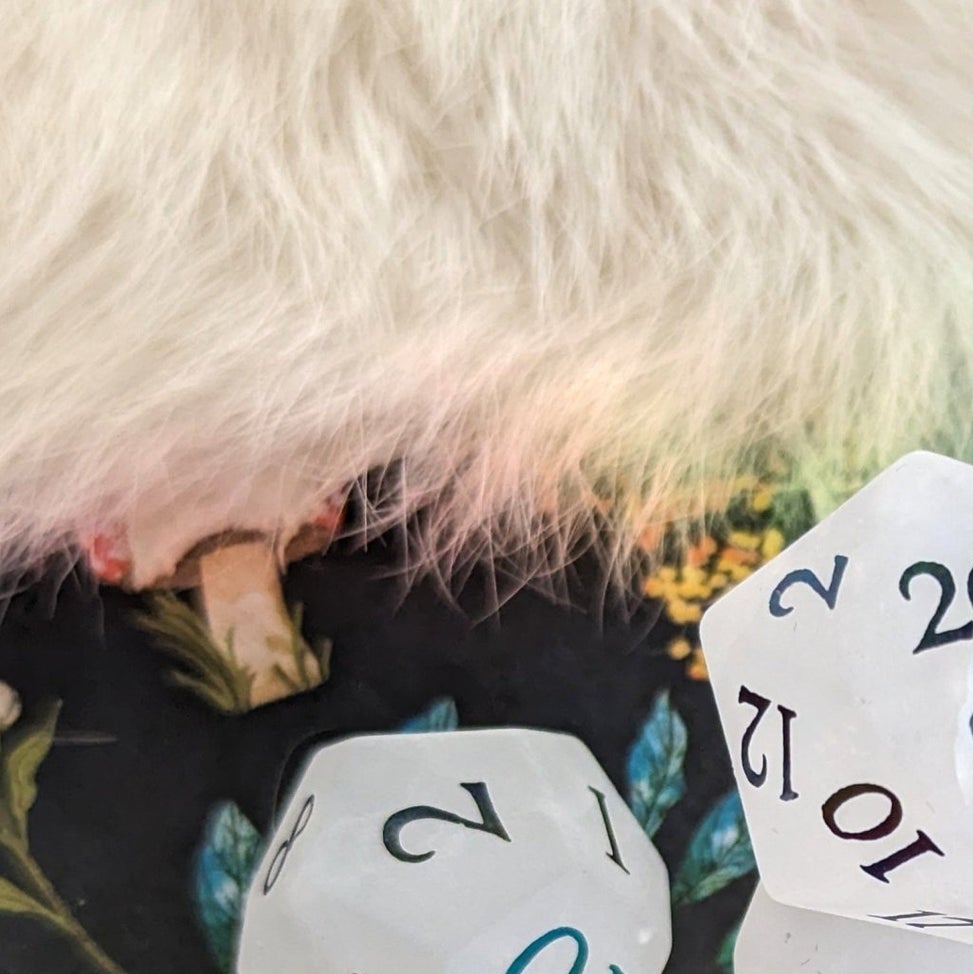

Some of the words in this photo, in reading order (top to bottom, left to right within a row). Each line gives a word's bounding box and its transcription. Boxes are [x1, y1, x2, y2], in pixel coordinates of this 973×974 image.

[768, 553, 848, 617] 2
[738, 685, 799, 801] 12
[263, 794, 315, 895] 8
[381, 781, 511, 863] 2
[821, 782, 945, 884] 10
